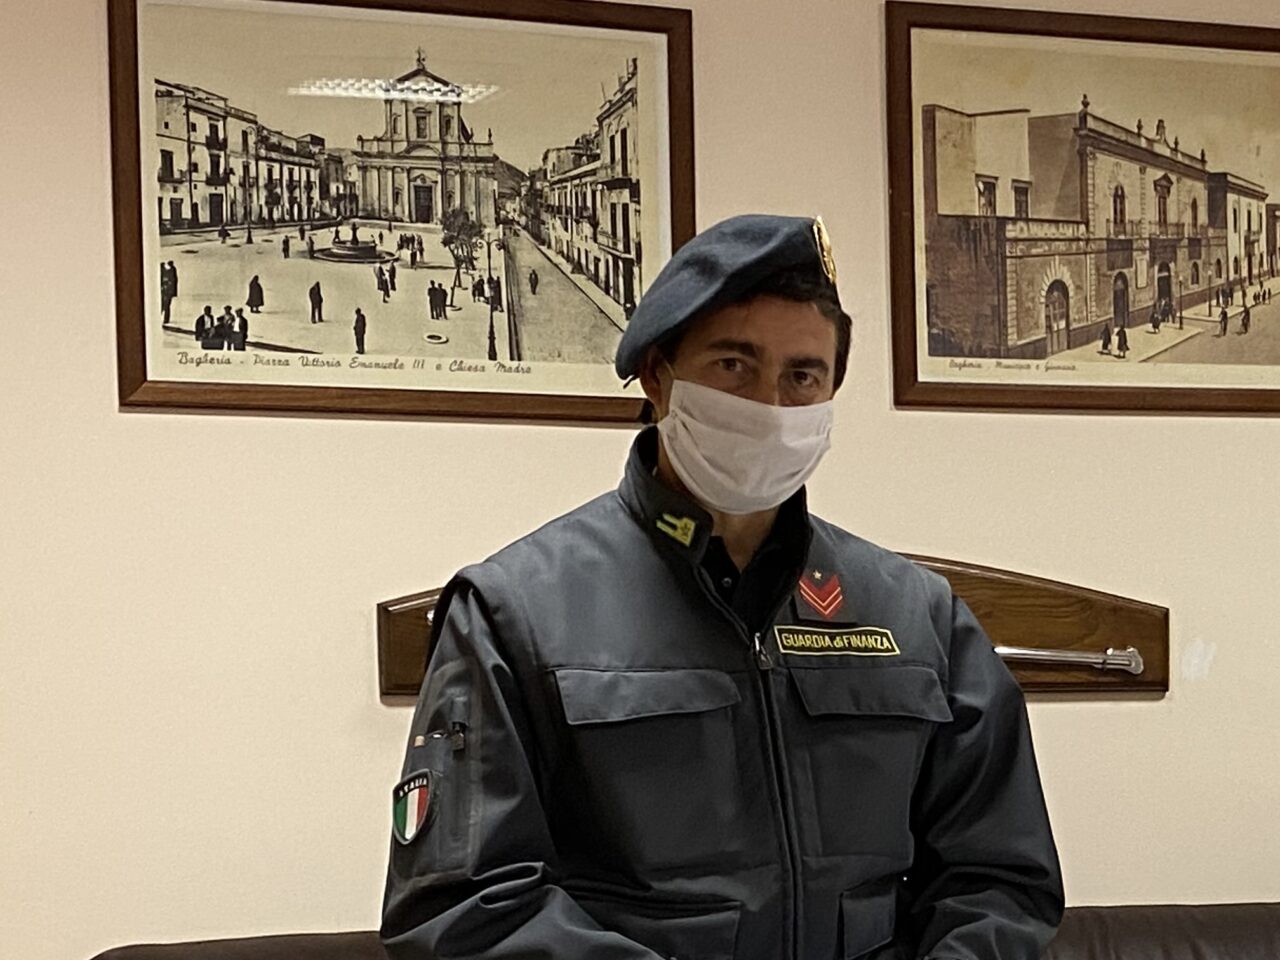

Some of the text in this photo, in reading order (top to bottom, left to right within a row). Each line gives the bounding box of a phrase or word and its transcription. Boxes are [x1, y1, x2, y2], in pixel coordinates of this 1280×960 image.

[177, 351, 232, 367] Bagheria
[350, 356, 405, 370] Emanuele
[449, 360, 486, 372] Chiesa
[494, 361, 532, 374] Madre
[781, 633, 892, 650] GUARDIA di FINANZA
[399, 777, 427, 797] ITALIA
